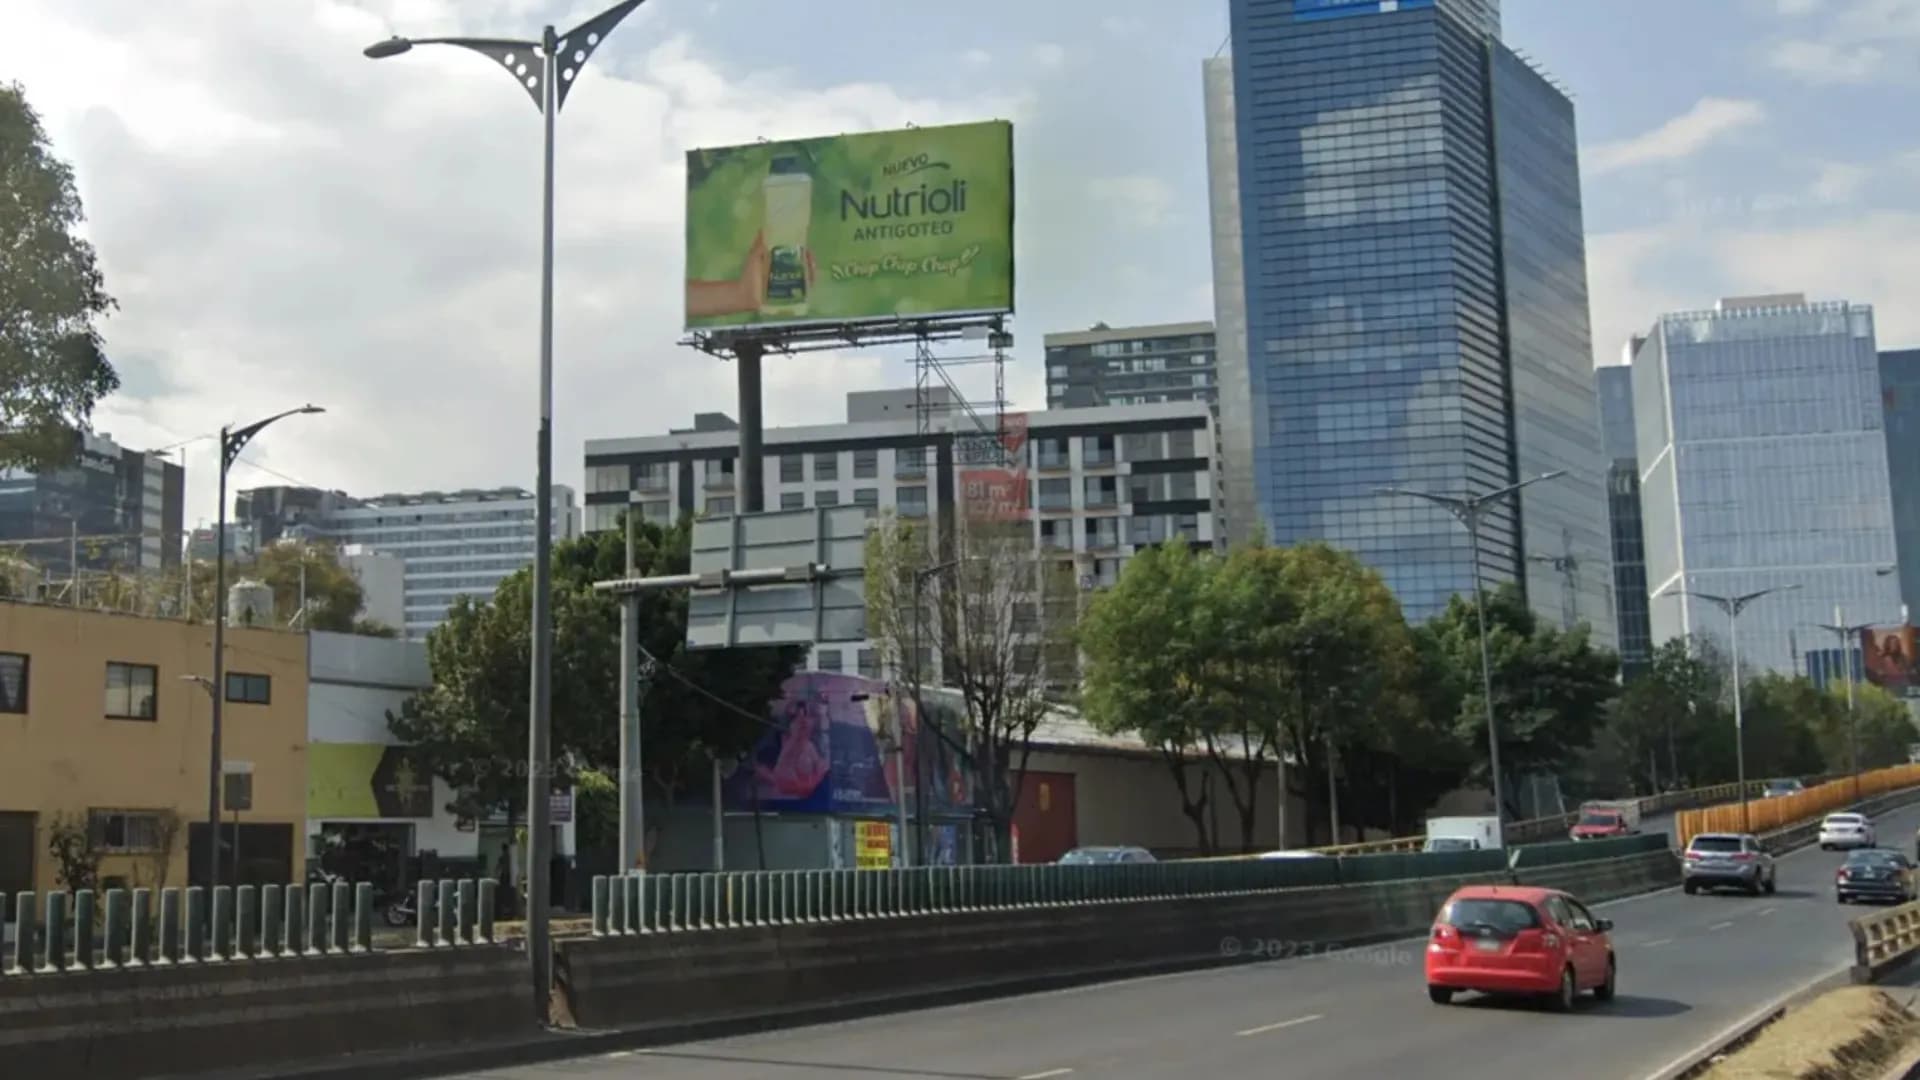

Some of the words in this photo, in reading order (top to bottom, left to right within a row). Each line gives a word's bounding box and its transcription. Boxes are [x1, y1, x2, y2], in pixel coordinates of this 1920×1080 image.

[883, 153, 928, 176] NUEVO
[841, 179, 966, 222] Nutrioli
[854, 221, 953, 241] ANTIGOTEO
